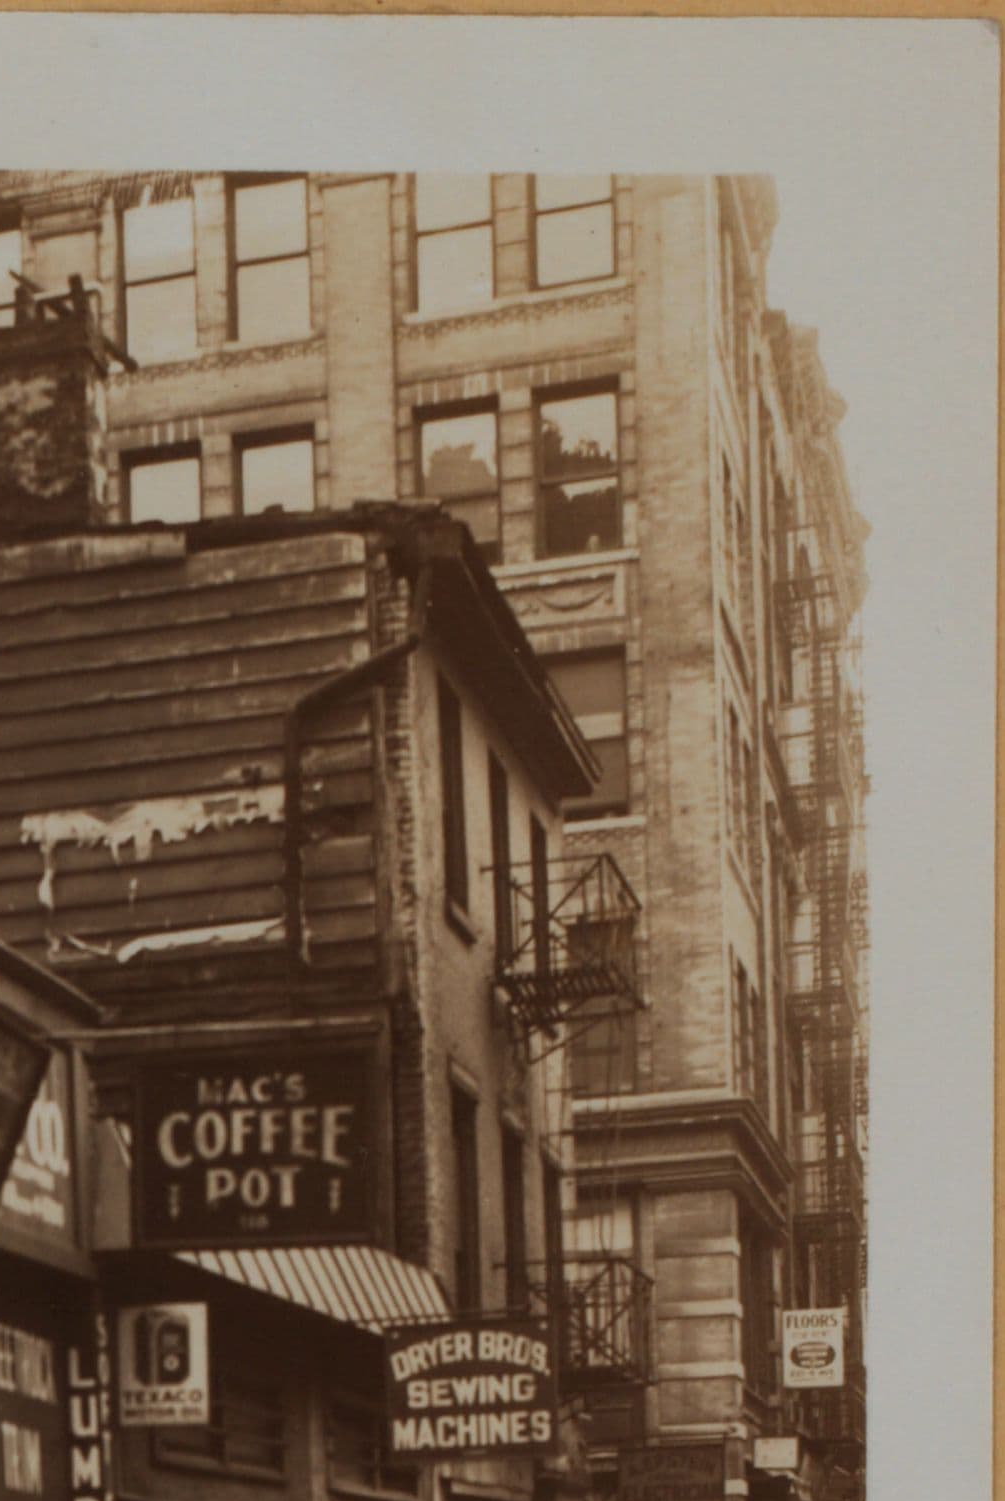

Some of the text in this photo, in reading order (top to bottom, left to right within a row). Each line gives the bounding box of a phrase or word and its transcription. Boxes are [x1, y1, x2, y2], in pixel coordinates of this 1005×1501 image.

[197, 1072, 305, 1105] MAC'S
[158, 1105, 354, 1168] COFFEE
[206, 1164, 303, 1207] POT
[786, 1314, 838, 1328] FLOORS
[391, 1331, 473, 1381] DRYER
[123, 1390, 202, 1404] TEXACO
[407, 1374, 537, 1409] SEWING
[393, 1410, 552, 1450] MACHINES
